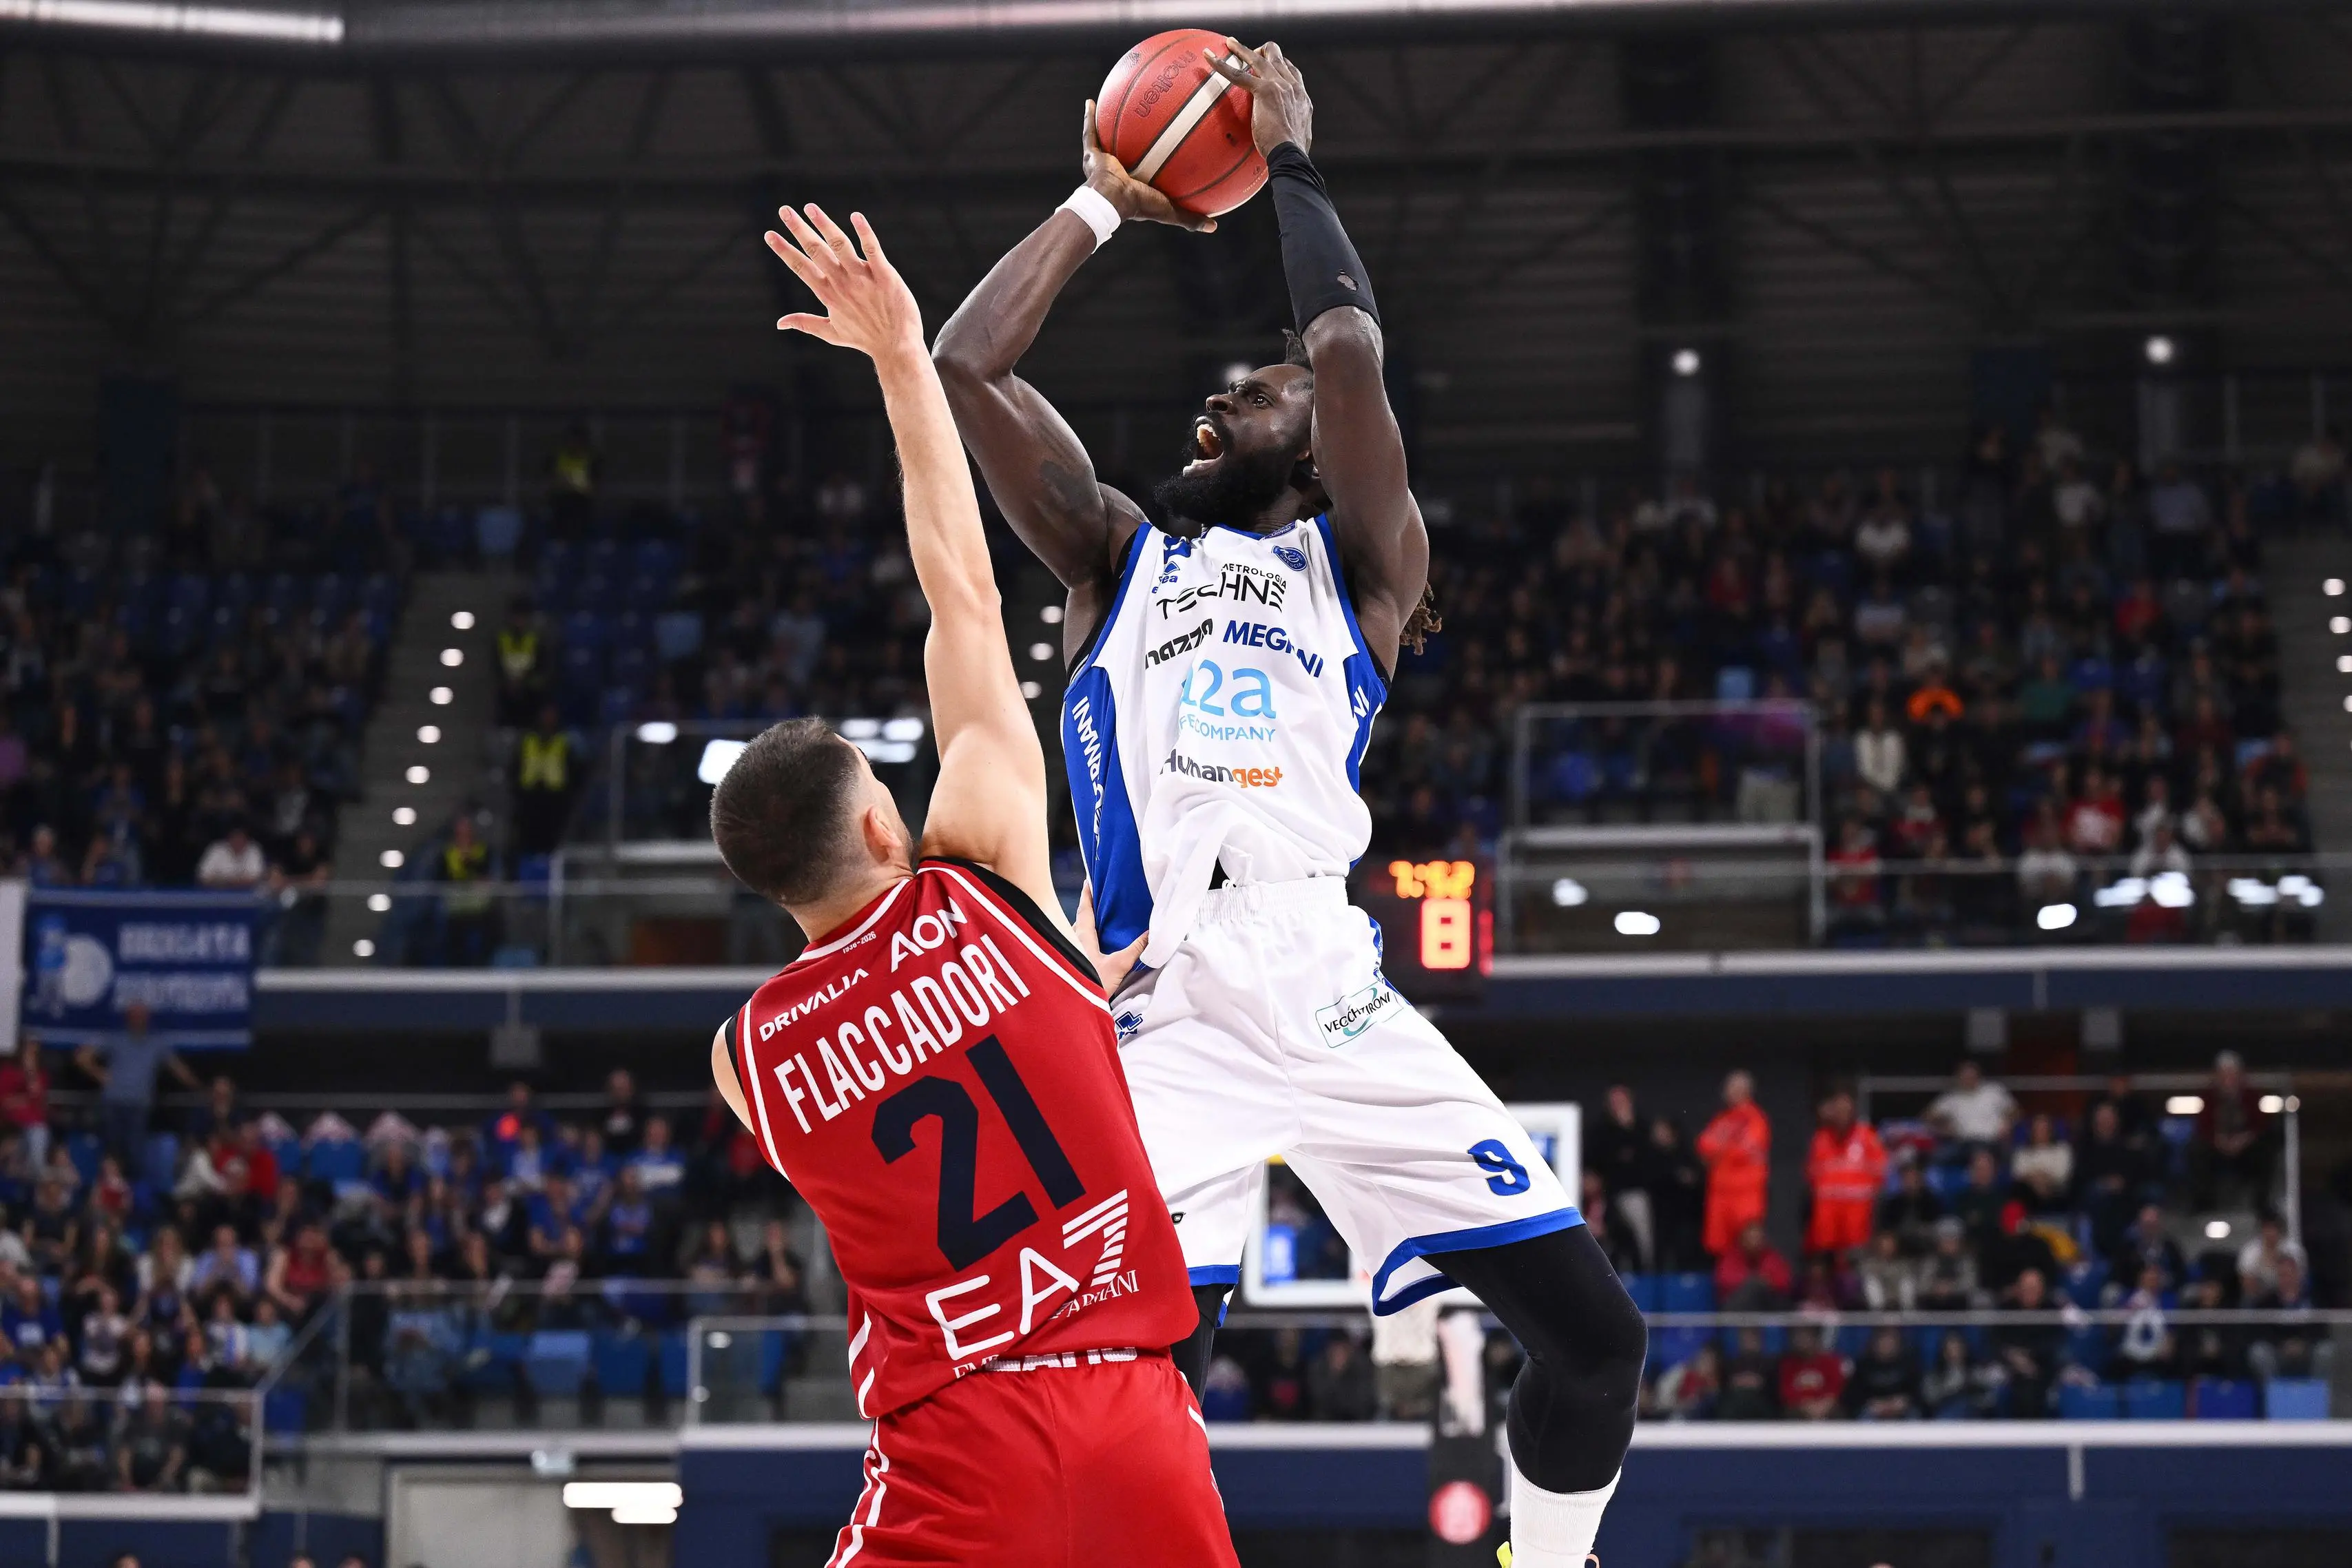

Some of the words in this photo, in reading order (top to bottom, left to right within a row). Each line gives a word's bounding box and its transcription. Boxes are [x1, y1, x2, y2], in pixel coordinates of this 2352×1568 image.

[1135, 50, 1197, 118] molten
[891, 896, 968, 973] AON
[1421, 897, 1471, 969] 8
[759, 968, 869, 1042] DRIVALIA
[774, 933, 1031, 1134] FLACCADORI
[871, 1033, 1086, 1272] 21
[1467, 1139, 1531, 1196] 9
[925, 1189, 1128, 1361] EA7
